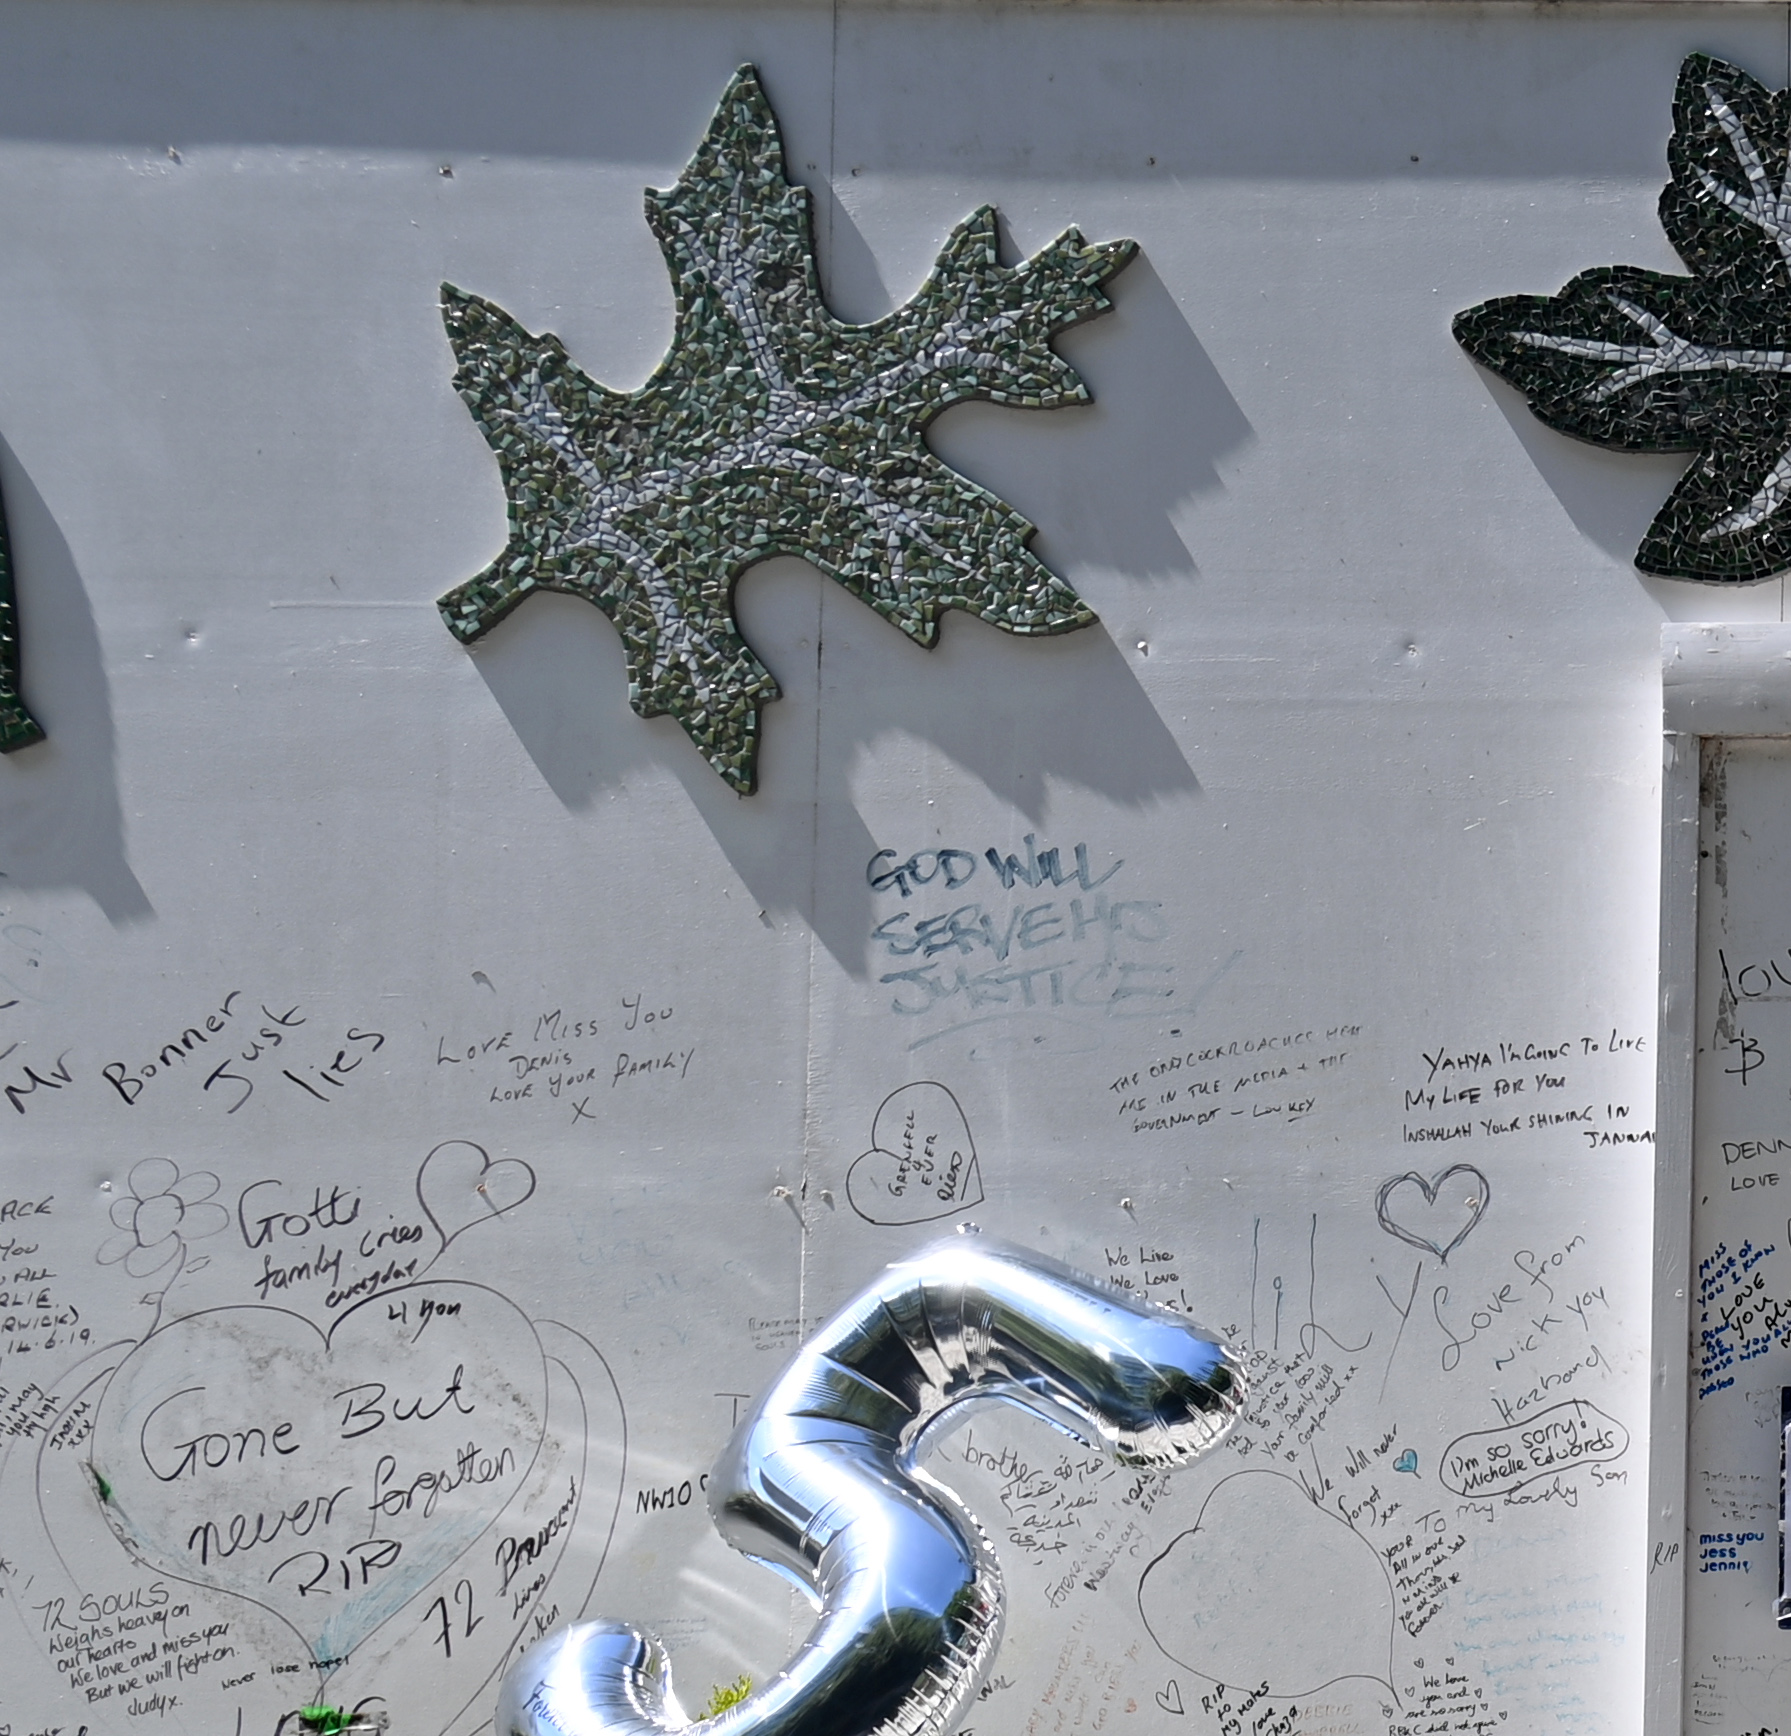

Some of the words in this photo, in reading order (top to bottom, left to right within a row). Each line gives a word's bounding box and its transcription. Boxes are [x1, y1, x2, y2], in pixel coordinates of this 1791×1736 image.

[867, 849, 978, 898] GOD
[985, 833, 1125, 891] WILL
[879, 960, 1197, 1019] JUSTICE
[1, 1047, 74, 1115] Mr
[100, 989, 242, 1106] Bonner
[281, 1026, 386, 1103] lies
[140, 1386, 300, 1482] Gone
[333, 1364, 475, 1439] But
[188, 1486, 354, 1567] never
[368, 1441, 516, 1540] forgotten
[268, 1538, 403, 1597] RIP
